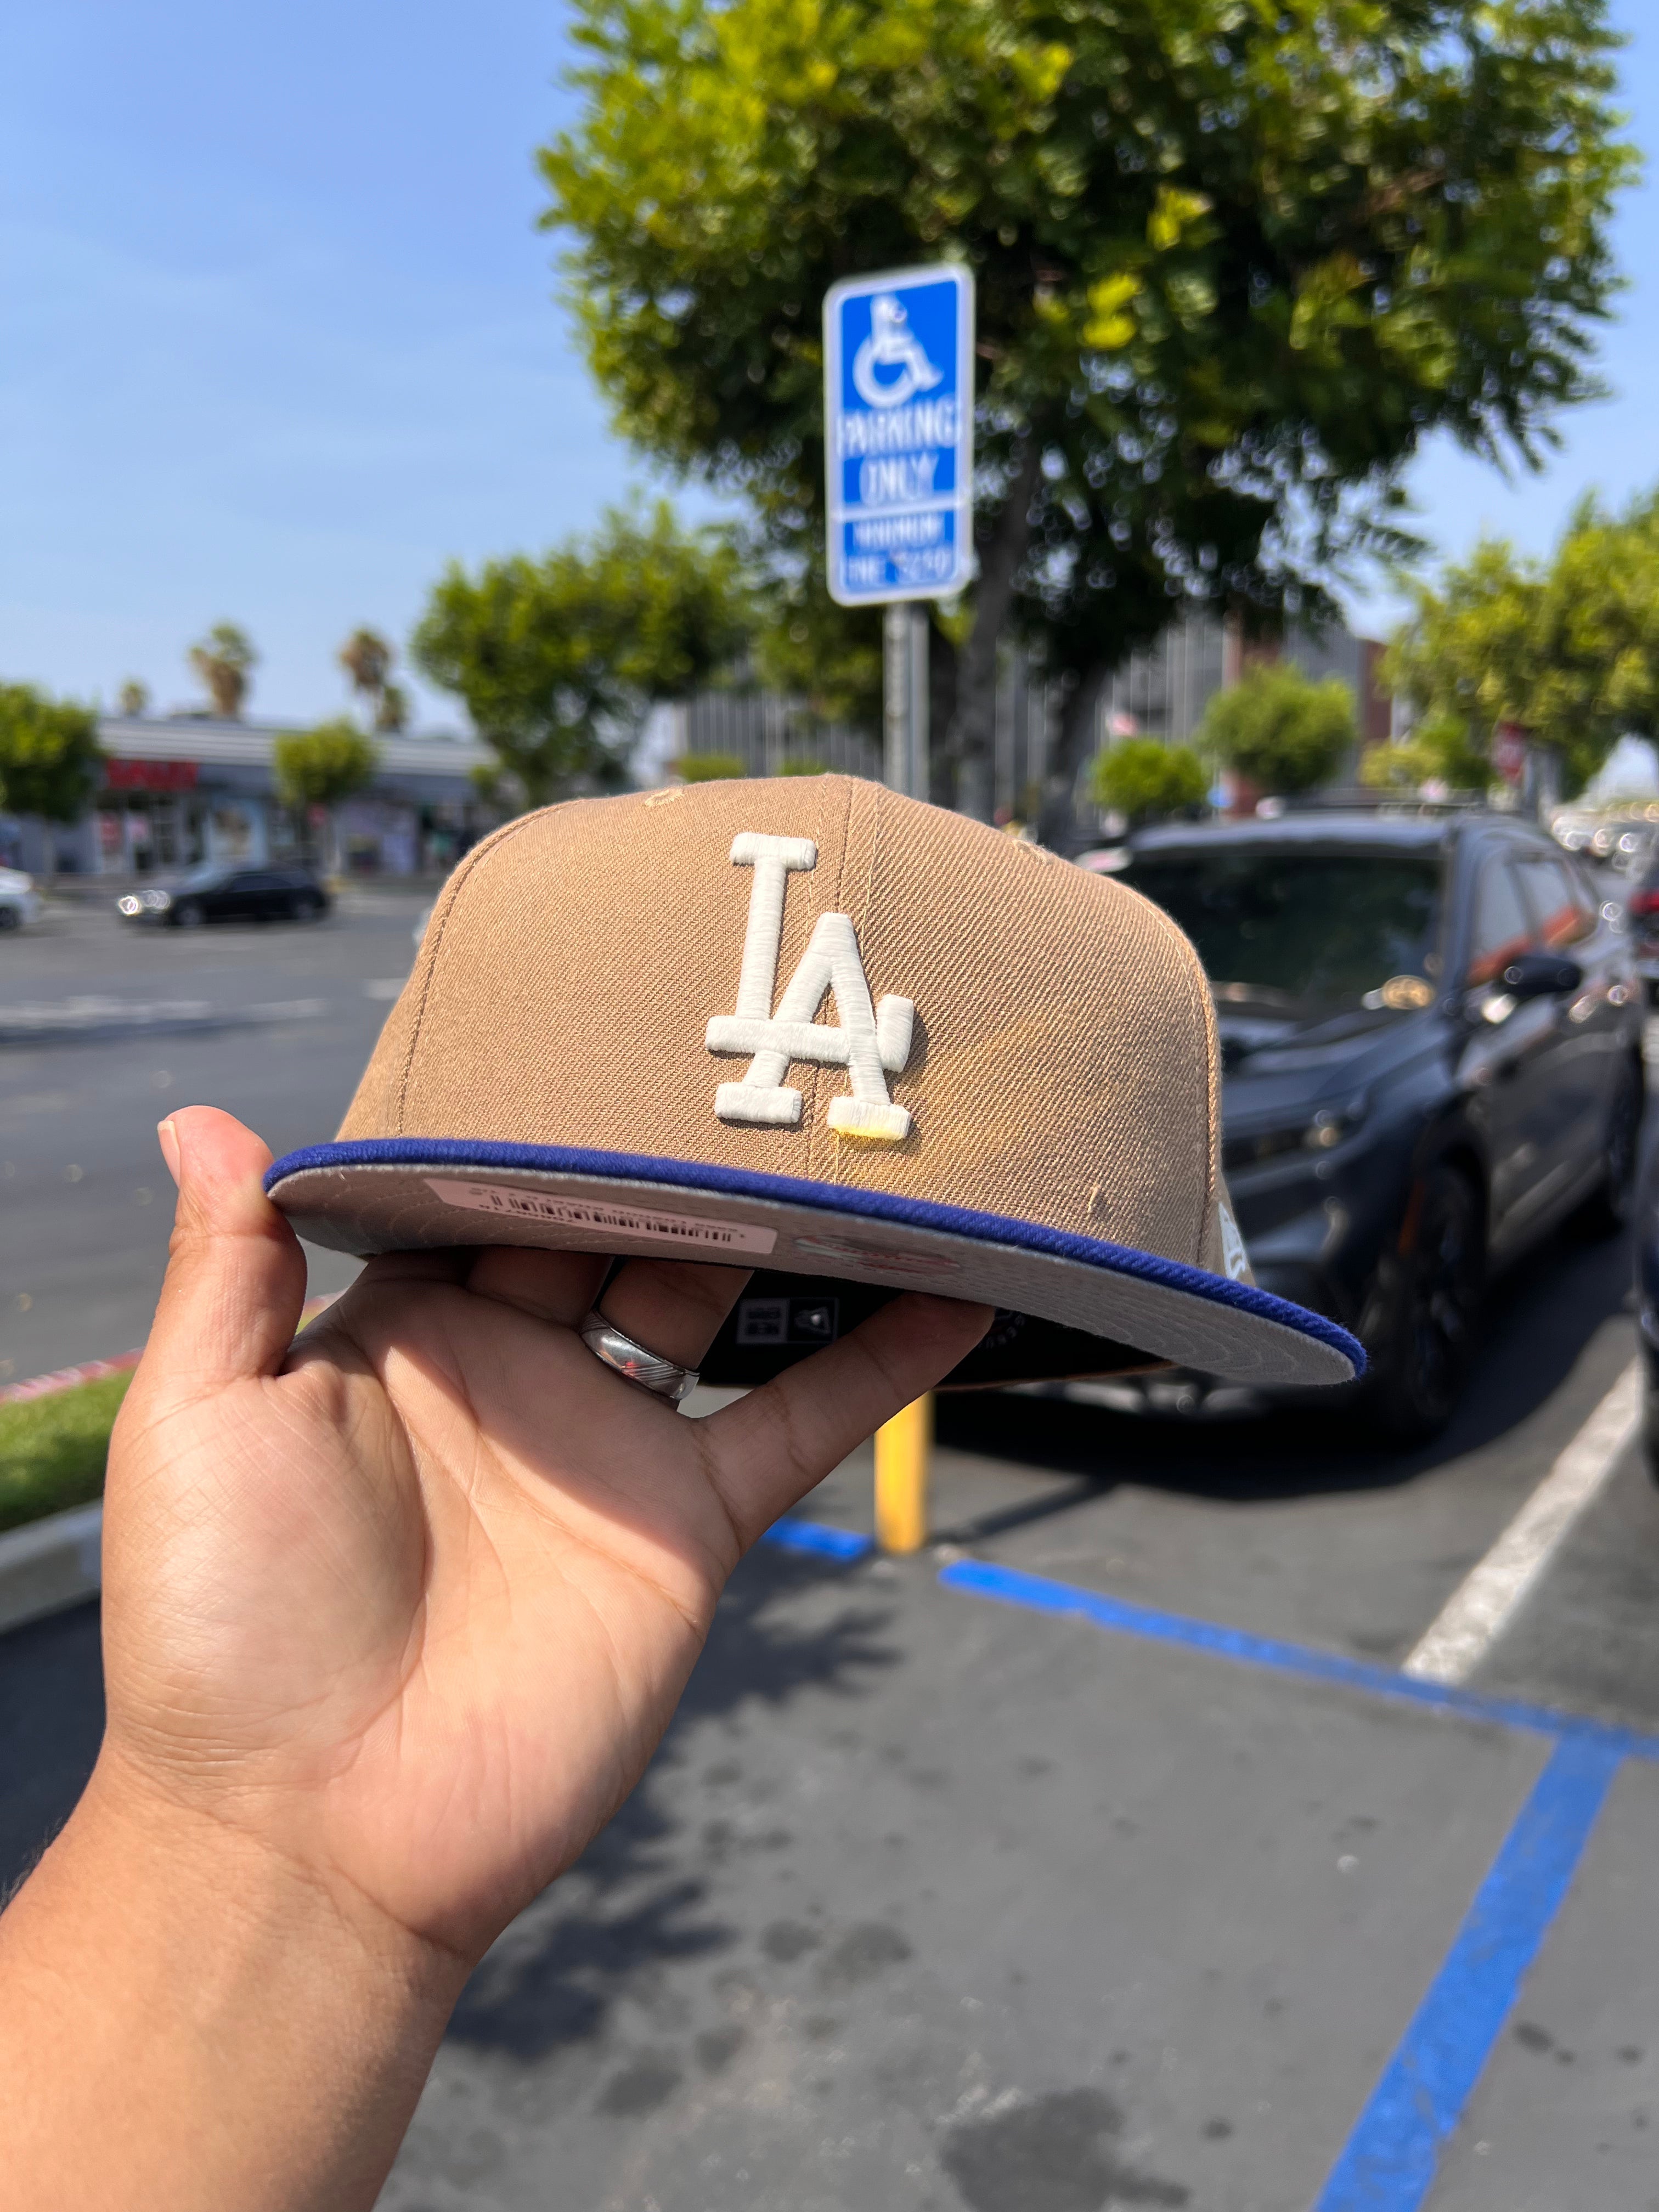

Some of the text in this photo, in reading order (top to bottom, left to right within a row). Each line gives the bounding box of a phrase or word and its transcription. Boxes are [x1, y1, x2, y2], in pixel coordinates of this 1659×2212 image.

[838, 399, 957, 456] PARKING
[860, 453, 939, 505] ONLY
[704, 832, 913, 1140] LA
